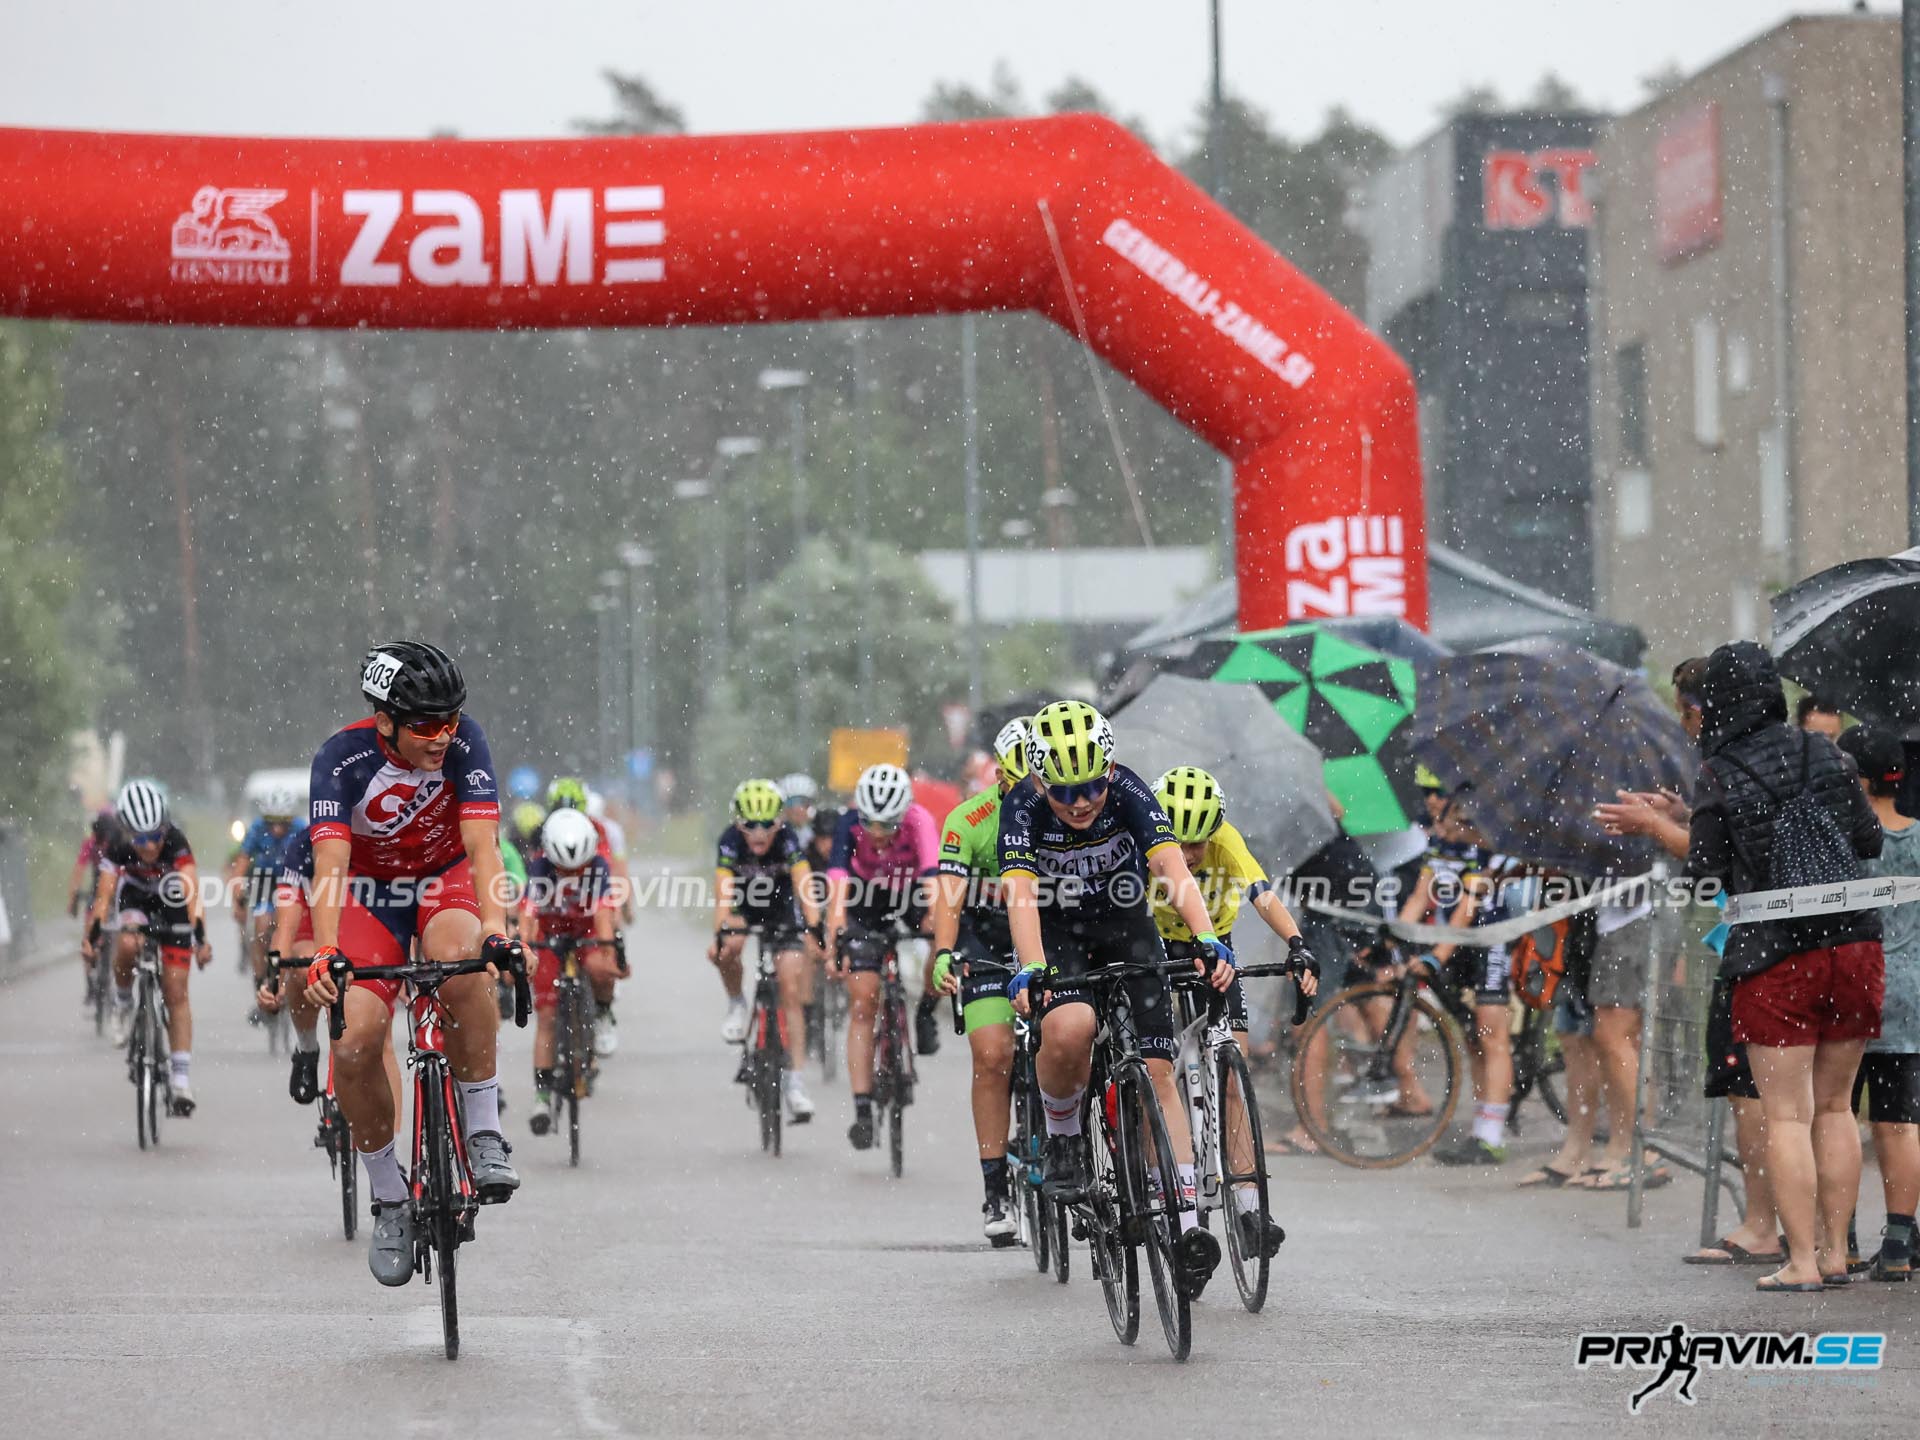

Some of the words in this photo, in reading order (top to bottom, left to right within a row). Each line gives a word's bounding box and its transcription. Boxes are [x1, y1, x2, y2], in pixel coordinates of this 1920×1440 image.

[364, 661, 395, 690] 303
[341, 749, 376, 768] ADRIA
[313, 799, 341, 820] FIAT
